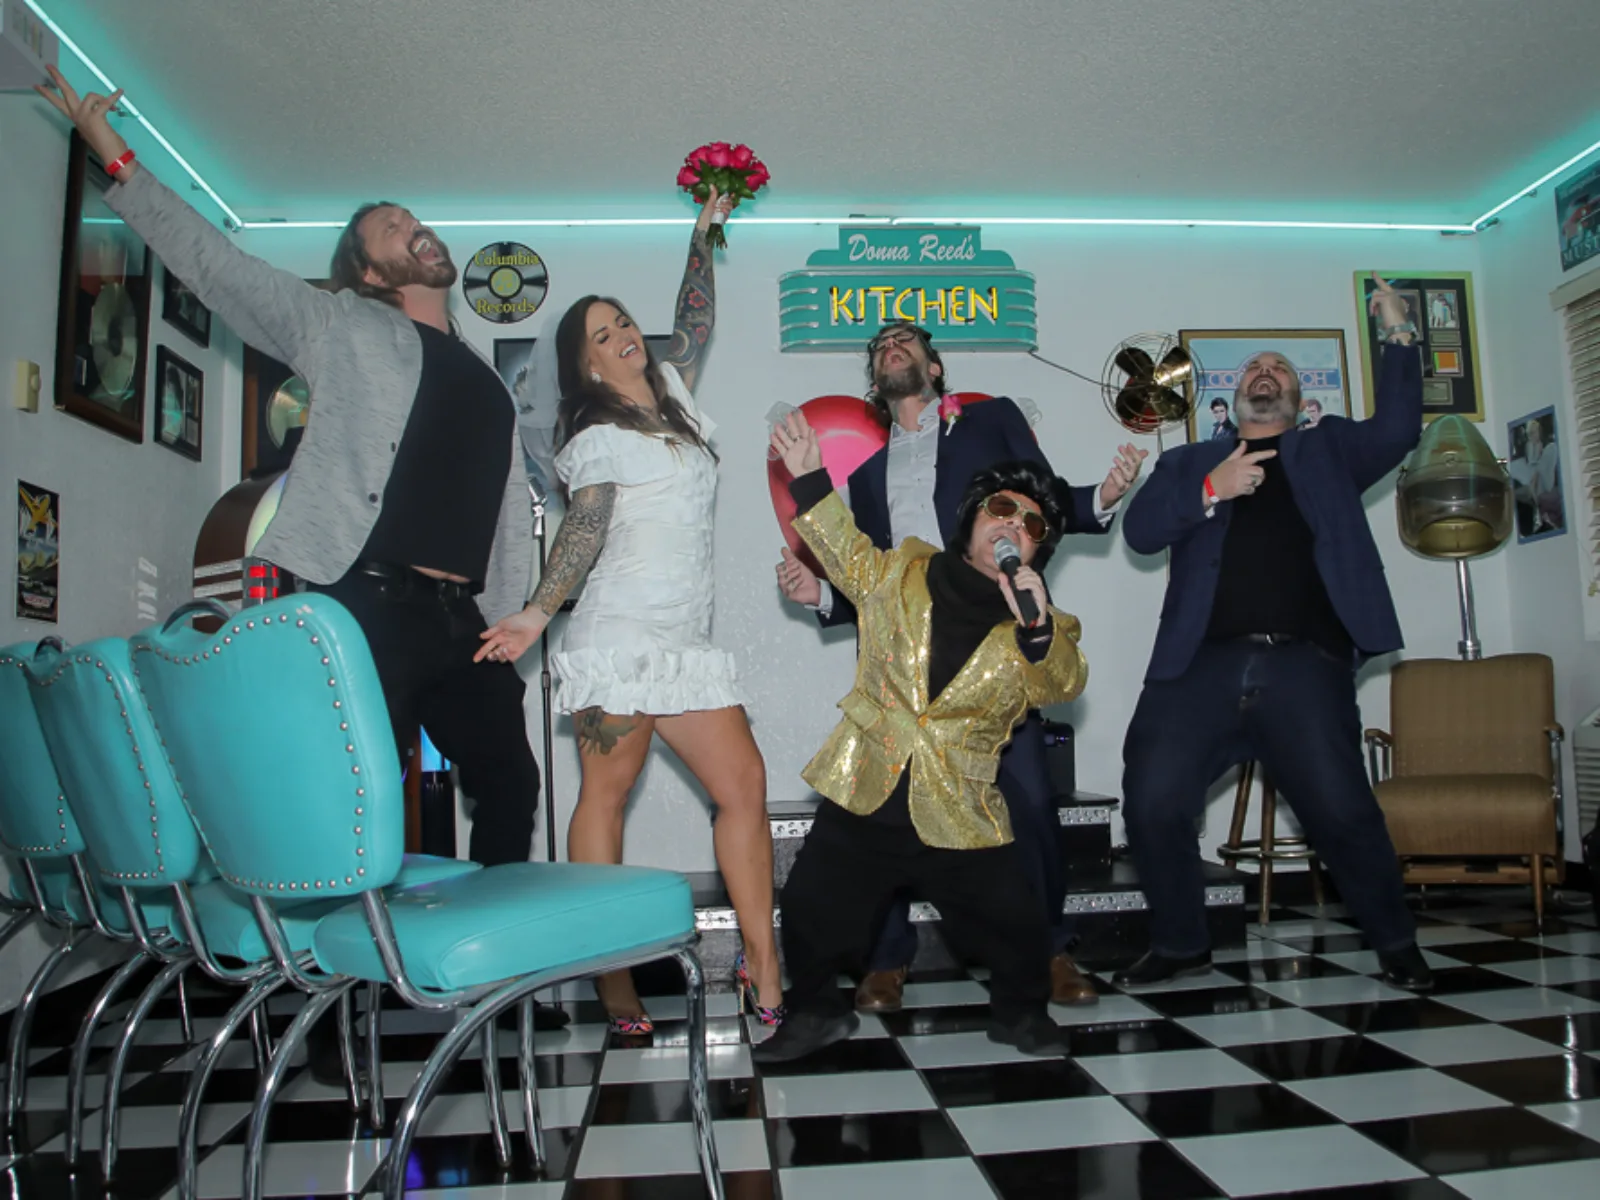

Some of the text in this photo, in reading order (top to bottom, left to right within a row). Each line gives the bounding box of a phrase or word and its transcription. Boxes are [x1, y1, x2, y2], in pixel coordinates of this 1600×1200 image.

[474, 250, 540, 266] Columbia
[848, 234, 976, 262] Donna Reed's
[476, 297, 537, 314] Records
[829, 285, 999, 325] KITCHEN
